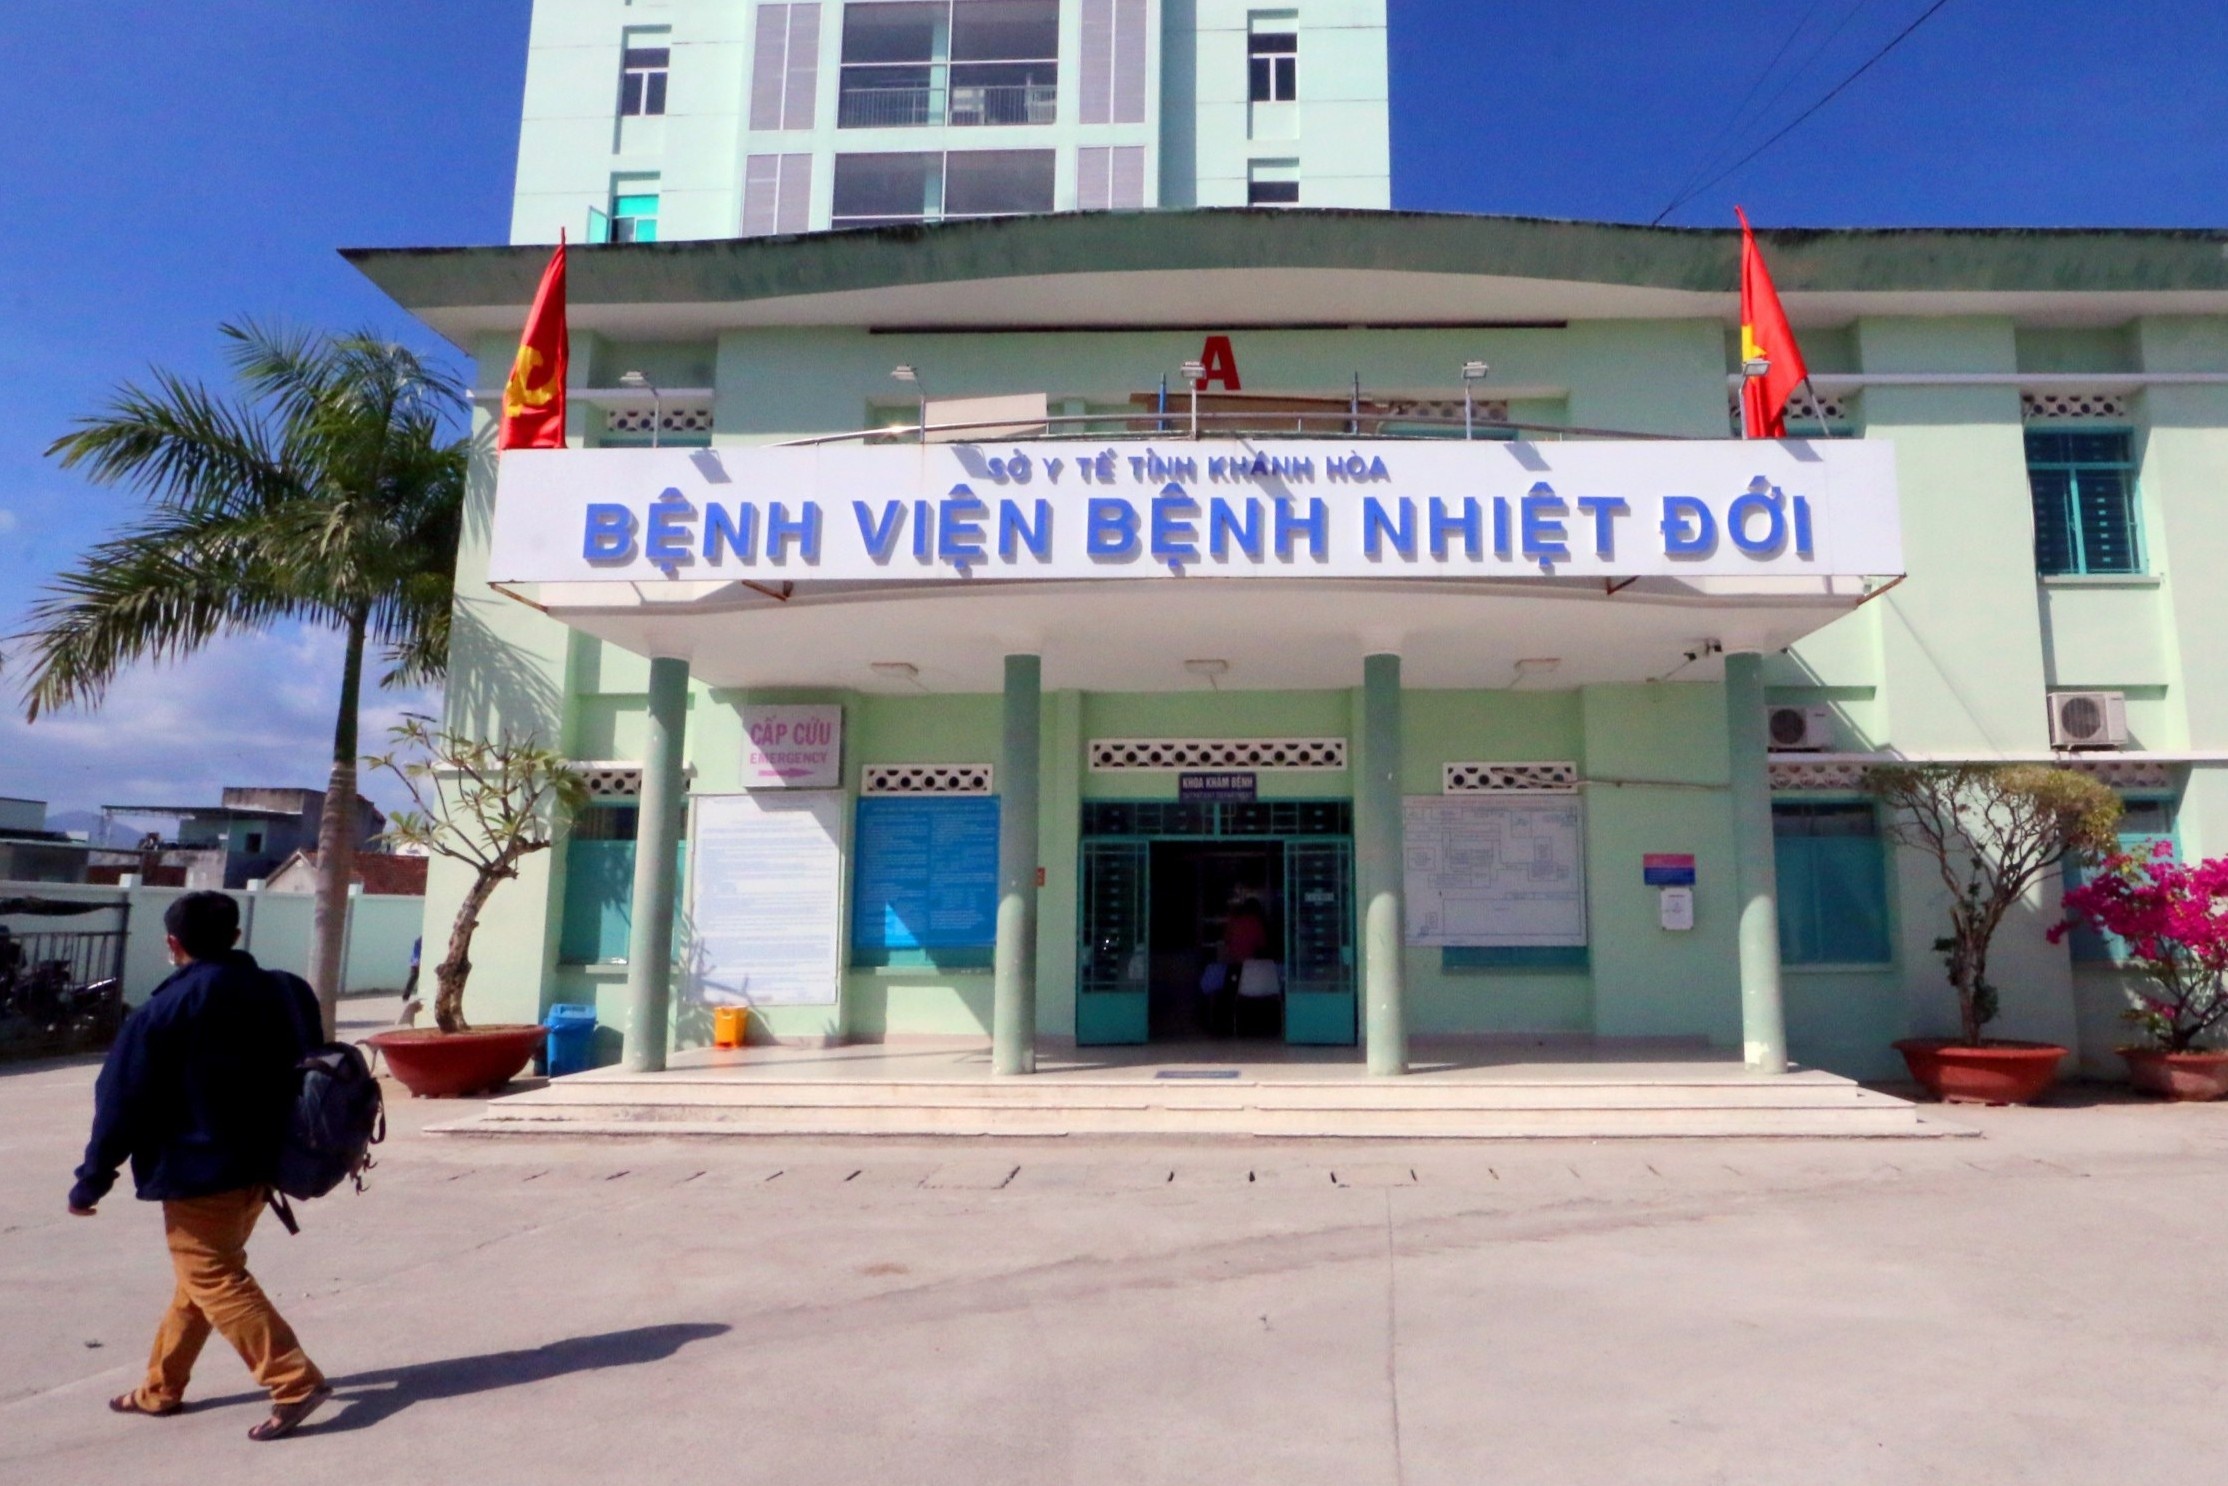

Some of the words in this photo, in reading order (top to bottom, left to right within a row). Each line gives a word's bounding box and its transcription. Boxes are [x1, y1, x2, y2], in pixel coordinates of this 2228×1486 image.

[1195, 335, 1241, 391] A
[1042, 457, 1062, 479] Y
[1075, 447, 1117, 479] TẾ
[1326, 449, 1389, 479] HÒA
[583, 486, 818, 572] BỆNH
[852, 484, 1050, 569] VIỆN
[1087, 483, 1324, 568] BỆNH
[1363, 482, 1627, 568] NHIỆT
[1659, 475, 1813, 554] ĐỚI
[750, 715, 788, 745] CẤP
[793, 716, 832, 745] CỨU
[750, 752, 828, 764] EMERGENCY
